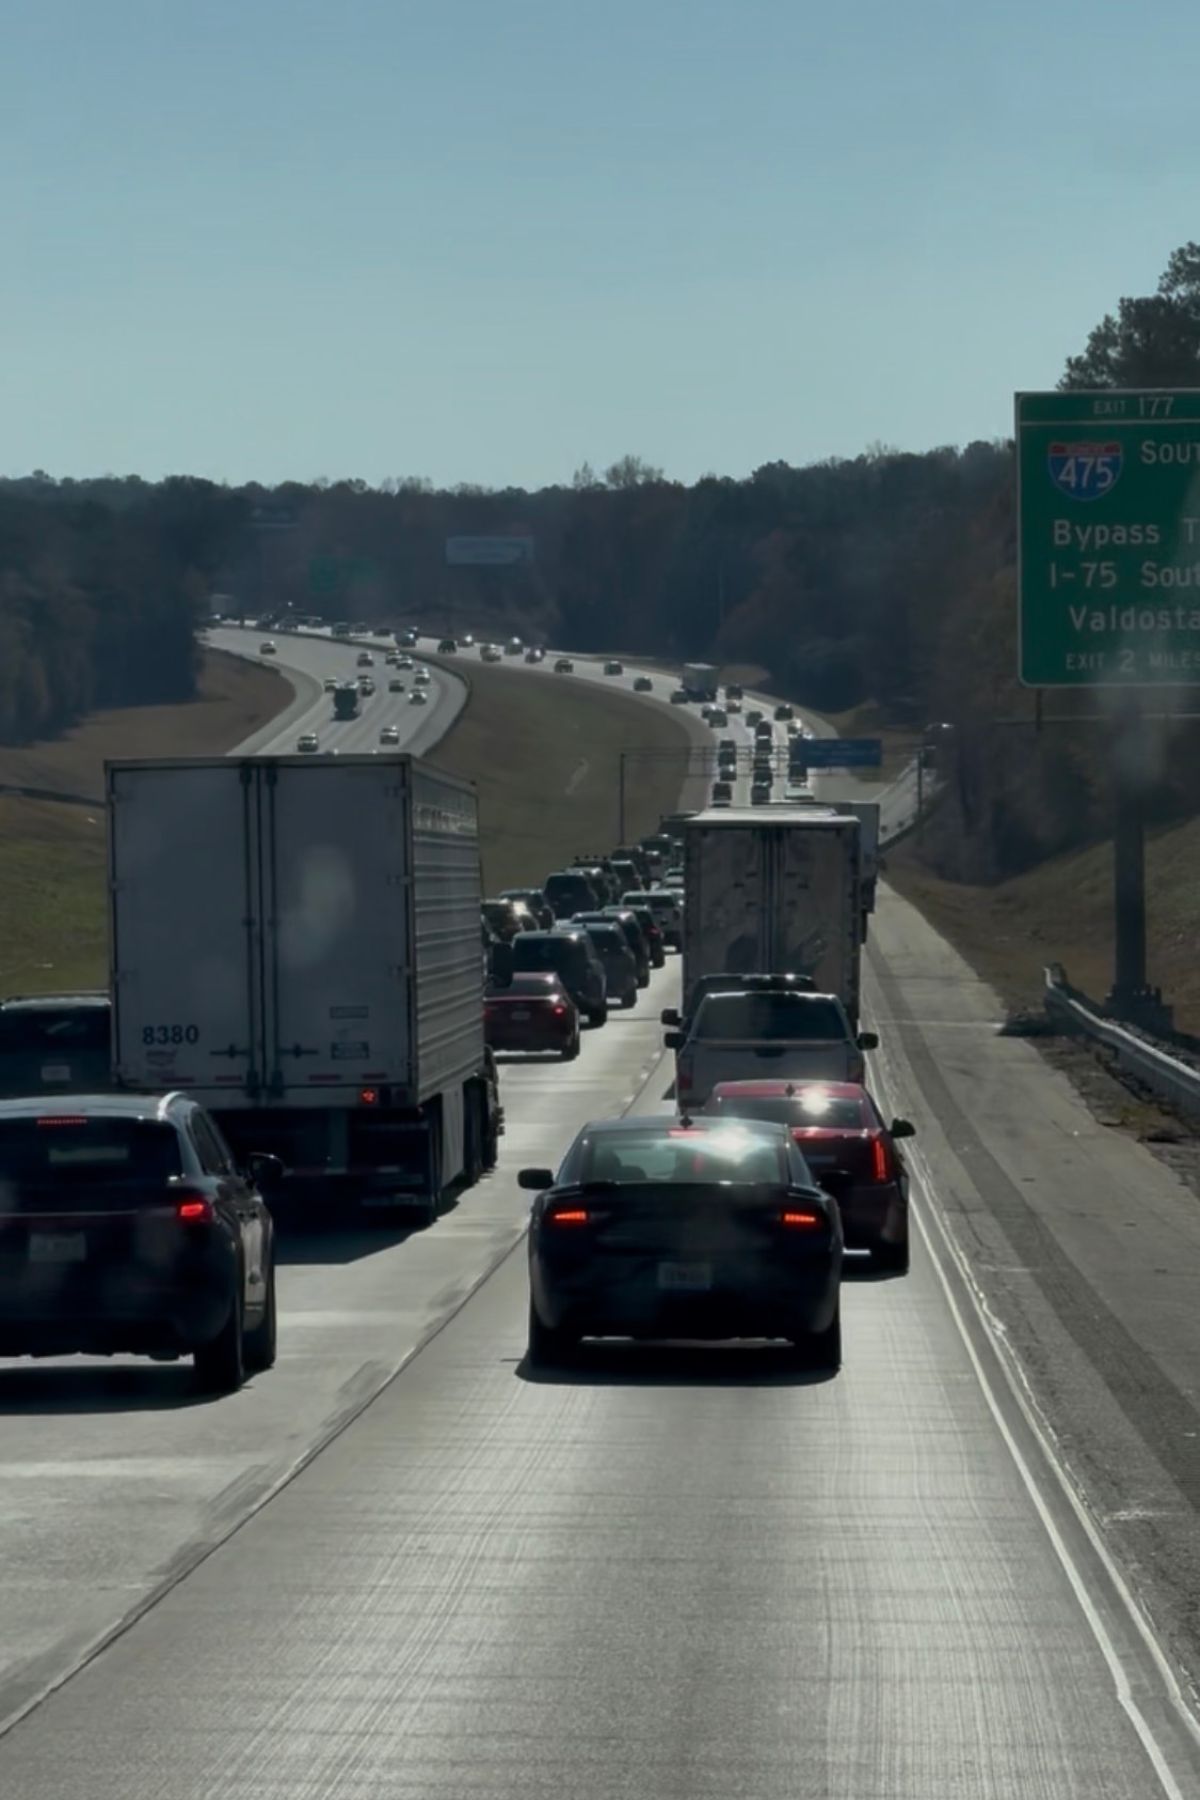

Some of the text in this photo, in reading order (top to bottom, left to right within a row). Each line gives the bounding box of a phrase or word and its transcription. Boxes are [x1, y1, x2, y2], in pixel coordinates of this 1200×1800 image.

[1093, 397, 1174, 416] EXIT 177
[1058, 457, 1113, 488] 475
[1054, 518, 1160, 552] Bypass
[1051, 561, 1117, 588] I-75
[1069, 605, 1200, 632] Valdosta
[1066, 652, 1104, 670] EXIT
[1118, 648, 1136, 673] 2
[142, 1024, 200, 1045] 8380
